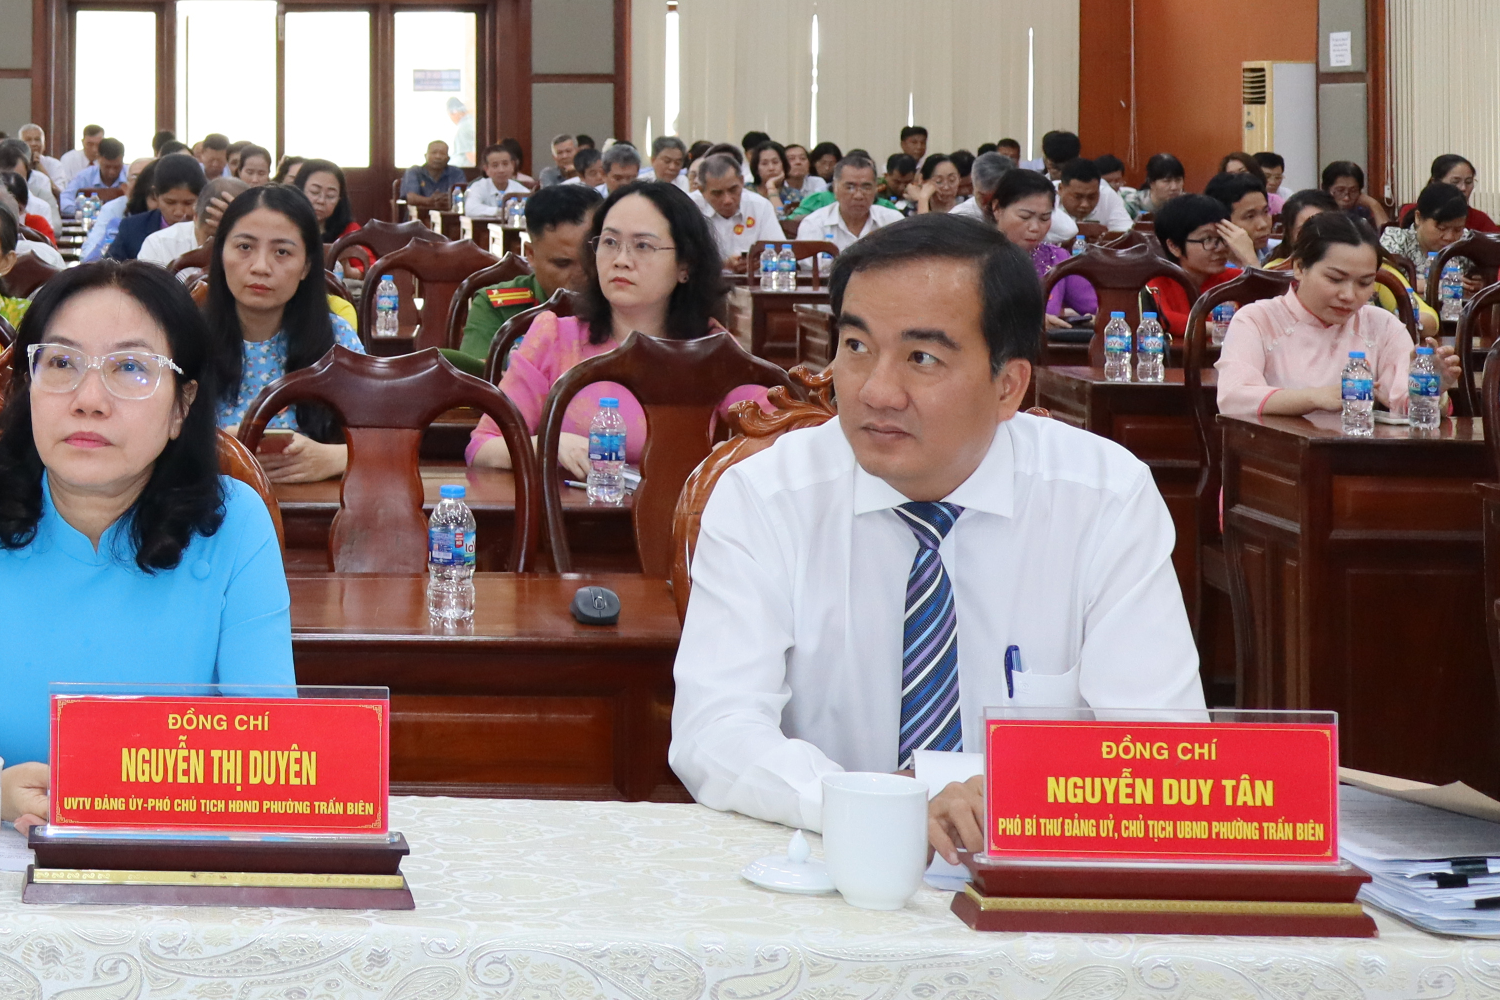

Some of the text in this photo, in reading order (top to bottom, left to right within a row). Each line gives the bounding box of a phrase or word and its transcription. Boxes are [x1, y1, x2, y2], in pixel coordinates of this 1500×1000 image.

[167, 708, 270, 731] ĐỒNG CHÍ
[1101, 734, 1218, 761] ĐỒNG CHÍ
[121, 735, 317, 792] NGUYỄN THỊ DUYÊN
[1046, 768, 1274, 807] NGUYỄN DUY TÂN
[63, 797, 91, 810] UVTV
[94, 794, 126, 811] ĐẢNG
[174, 796, 197, 812] CHỦ
[200, 799, 225, 814] TỊCH
[228, 800, 260, 813] HĐND
[263, 798, 311, 814] PHƯỜNG
[314, 797, 344, 815] TRẤN
[347, 800, 374, 815] BIÊN
[998, 813, 1325, 842] PHÓ BÍ THƯ ĐẢNG UỶ, CHỦ TỊCH UBND PHƯỜNG TRẤN BIÊN
